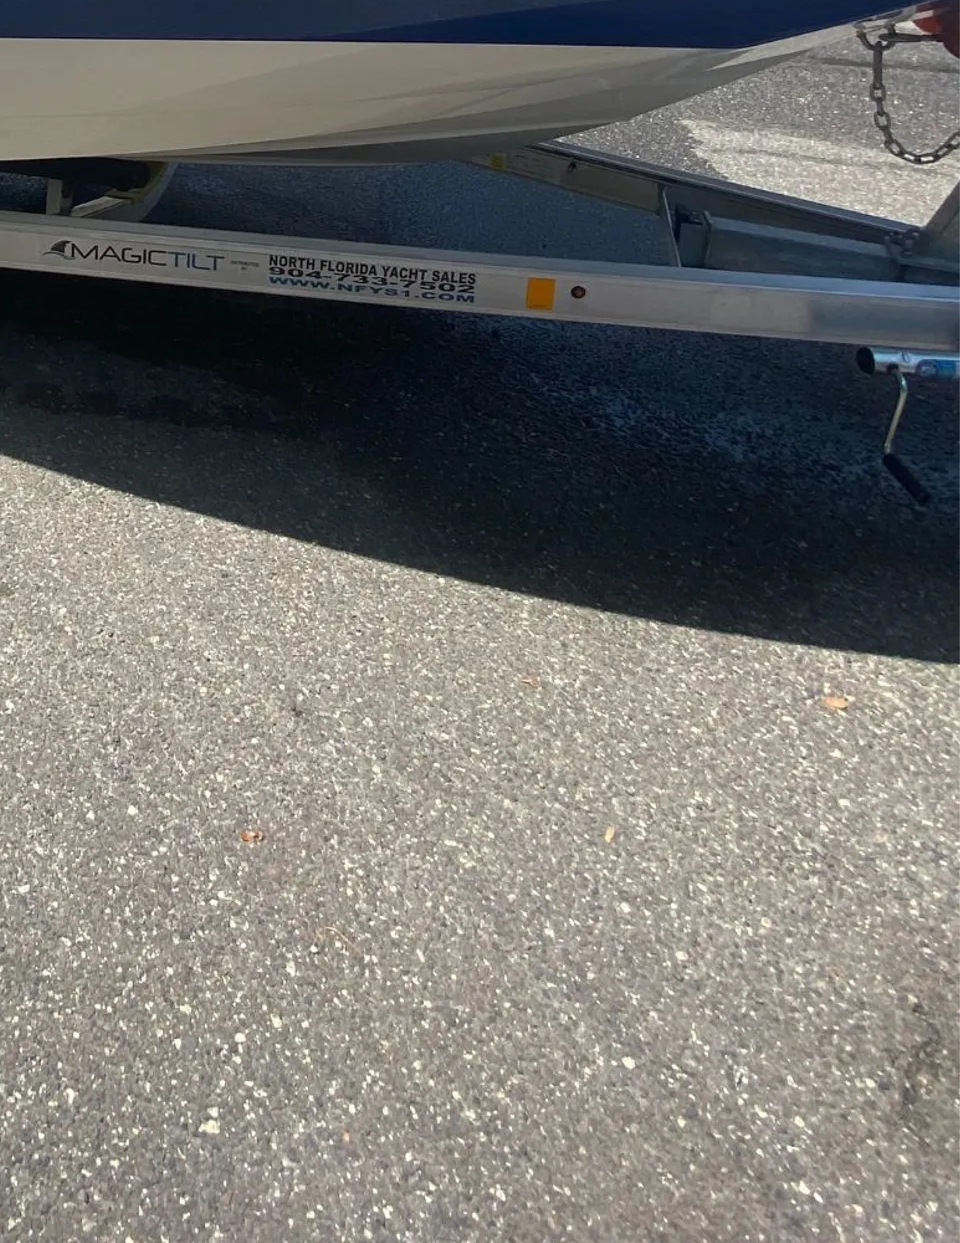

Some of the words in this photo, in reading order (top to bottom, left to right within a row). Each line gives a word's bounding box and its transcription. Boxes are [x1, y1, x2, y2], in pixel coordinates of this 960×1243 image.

[70, 242, 225, 271] MAGICTILT
[268, 255, 316, 271] NORTH
[319, 259, 378, 277] FLORIDA
[381, 265, 429, 281] YACHT
[431, 270, 477, 285] SALES
[268, 266, 476, 294] 904-733-7502
